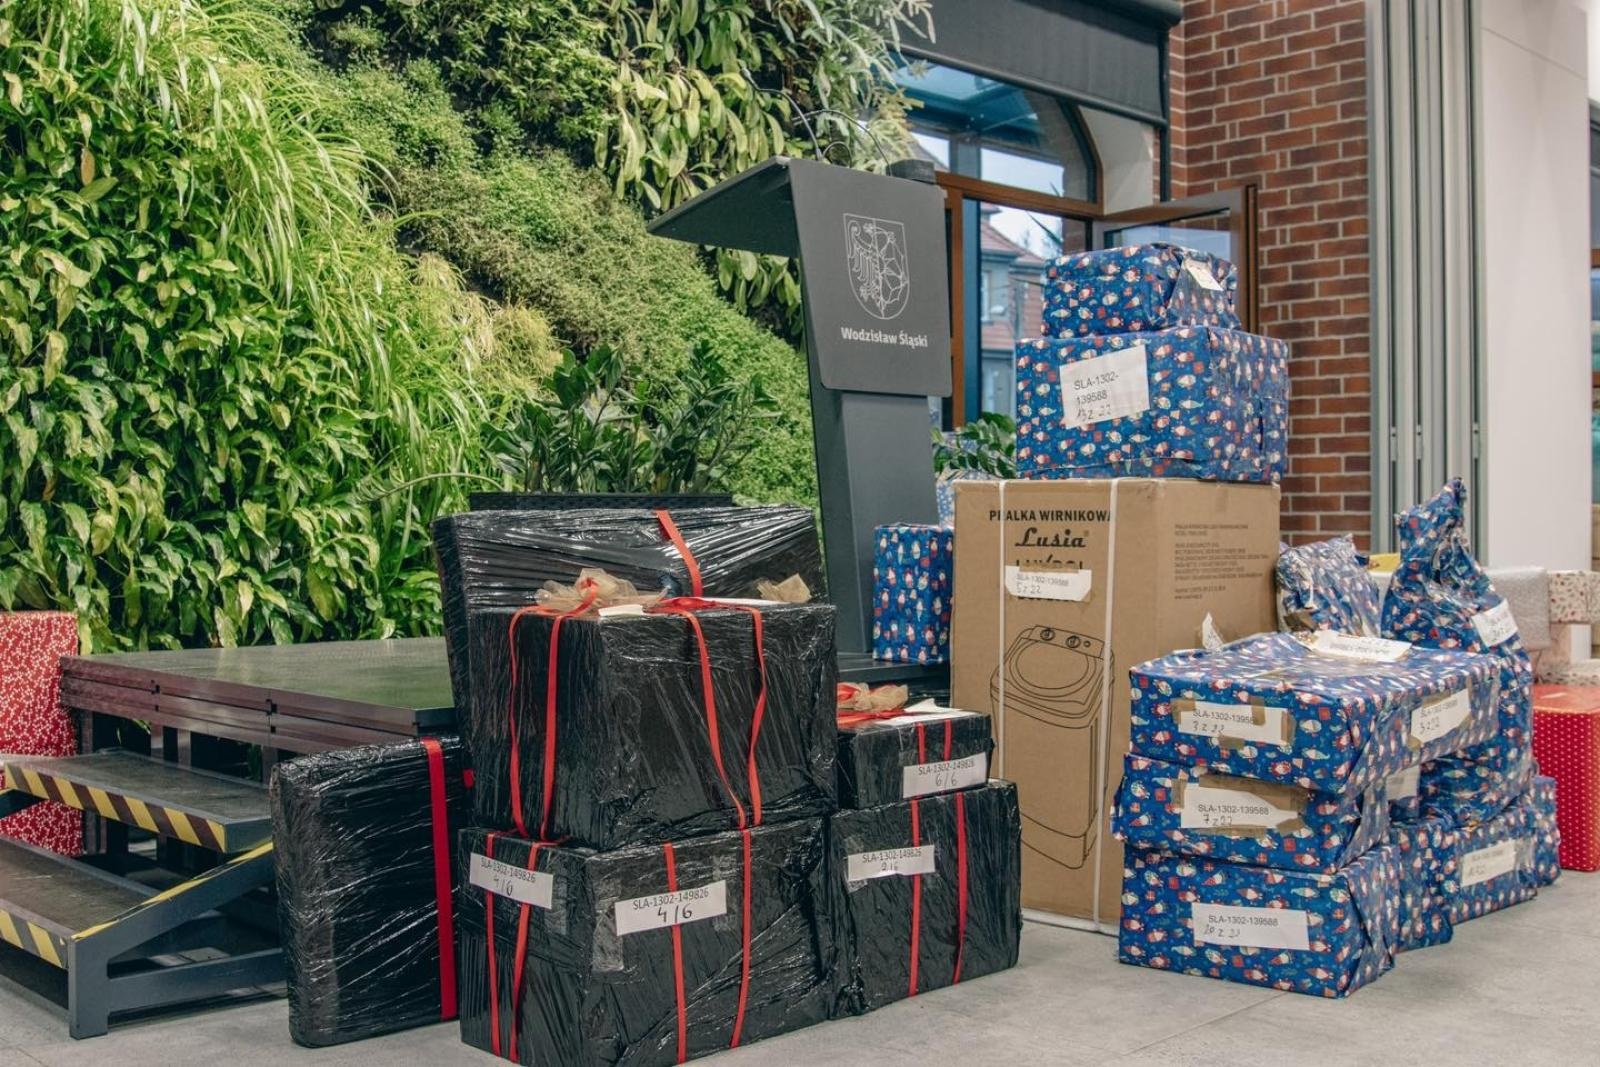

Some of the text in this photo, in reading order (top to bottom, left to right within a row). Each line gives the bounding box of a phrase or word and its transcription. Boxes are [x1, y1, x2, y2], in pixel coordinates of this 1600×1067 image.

[840, 327, 928, 349] Wodzisław Śląski
[1073, 371, 1119, 390] SLA-1302-
[1014, 526, 1087, 548] Lusia
[1197, 803, 1270, 816] SLA-1302-139588
[632, 887, 709, 911] SLA-1302-149826
